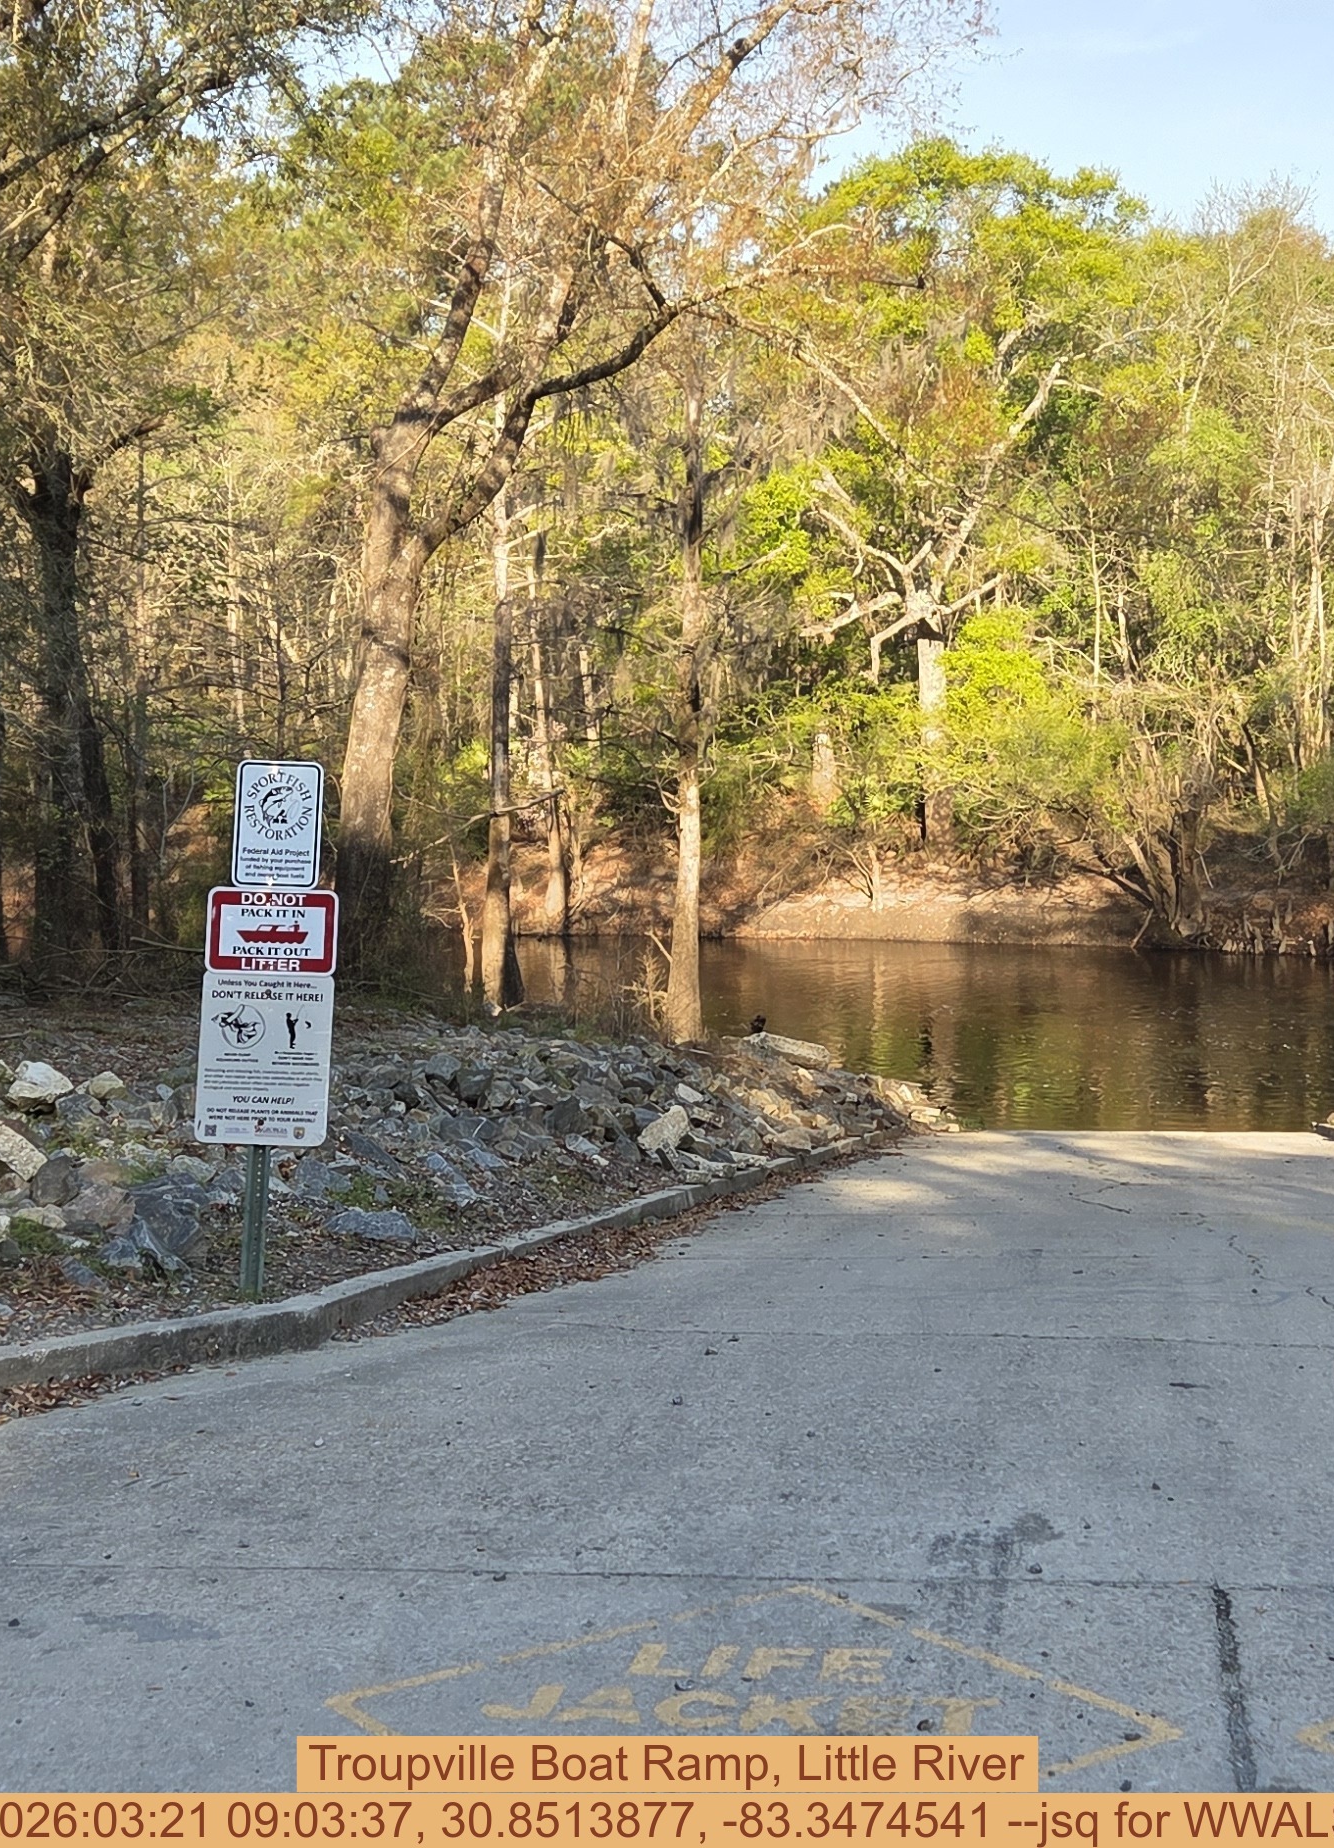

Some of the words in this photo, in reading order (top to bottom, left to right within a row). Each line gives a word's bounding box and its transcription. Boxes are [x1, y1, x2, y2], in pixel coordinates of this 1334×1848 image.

[244, 805, 313, 841] RESTORATION
[242, 847, 269, 855] Federal
[284, 849, 310, 858] Project
[241, 893, 267, 905] DO
[271, 894, 307, 906] NOT
[241, 908, 272, 918] PACK
[276, 909, 289, 918] IT
[292, 910, 306, 918] IN
[232, 946, 265, 955] PACK
[267, 947, 281, 956] IT
[283, 948, 312, 957] OUT
[241, 958, 301, 971] LITTER
[259, 980, 284, 989] Caught
[211, 990, 242, 999] DON'T
[244, 991, 283, 1000] RELEASE
[285, 992, 294, 1001] IT
[296, 993, 323, 1002] HERE!
[232, 1095, 251, 1103] YOU
[251, 1096, 269, 1104] CAN
[270, 1097, 295, 1105] HELP!
[626, 1642, 893, 1684] LIFE
[479, 1684, 1005, 1736] JACKET
